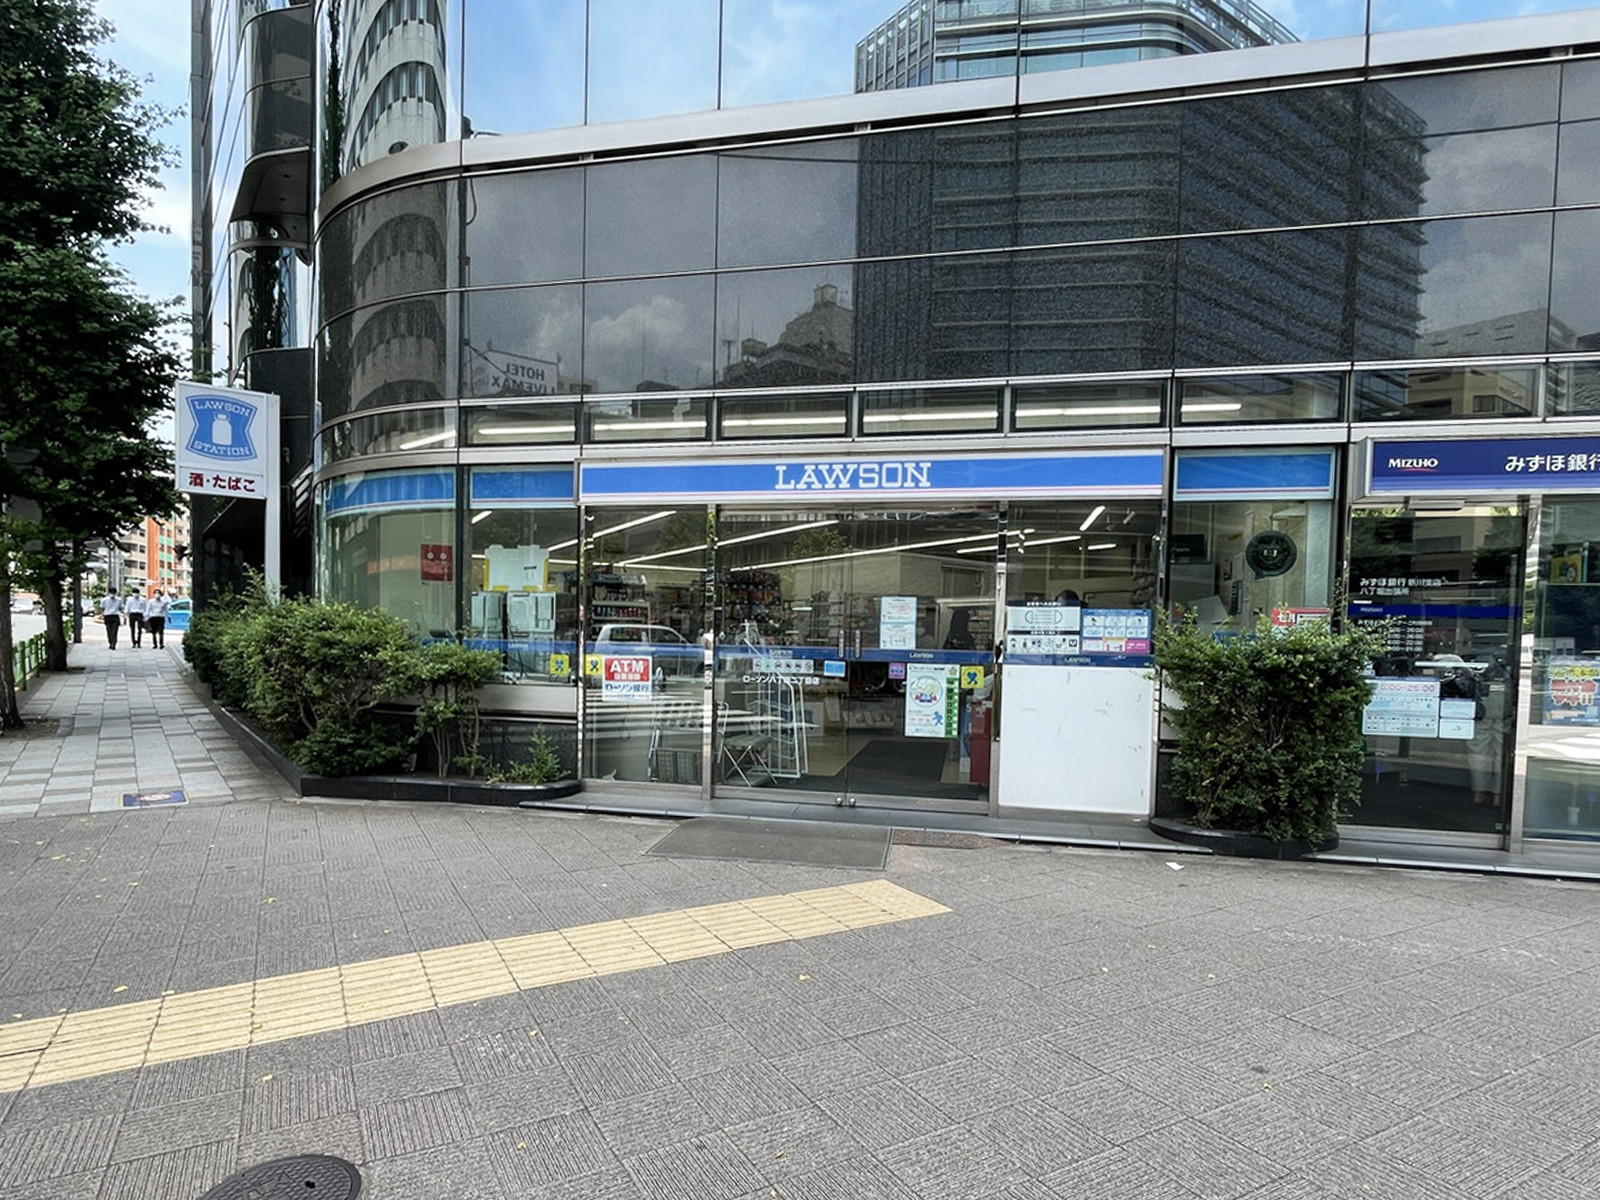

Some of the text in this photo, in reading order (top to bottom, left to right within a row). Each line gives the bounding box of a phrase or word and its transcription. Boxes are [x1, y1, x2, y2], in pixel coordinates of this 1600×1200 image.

[194, 400, 251, 416] LAWSON
[193, 440, 251, 456] STATION
[1388, 457, 1439, 469] MIZUHO
[775, 462, 932, 490] LAWSON
[610, 660, 644, 673] ATM
